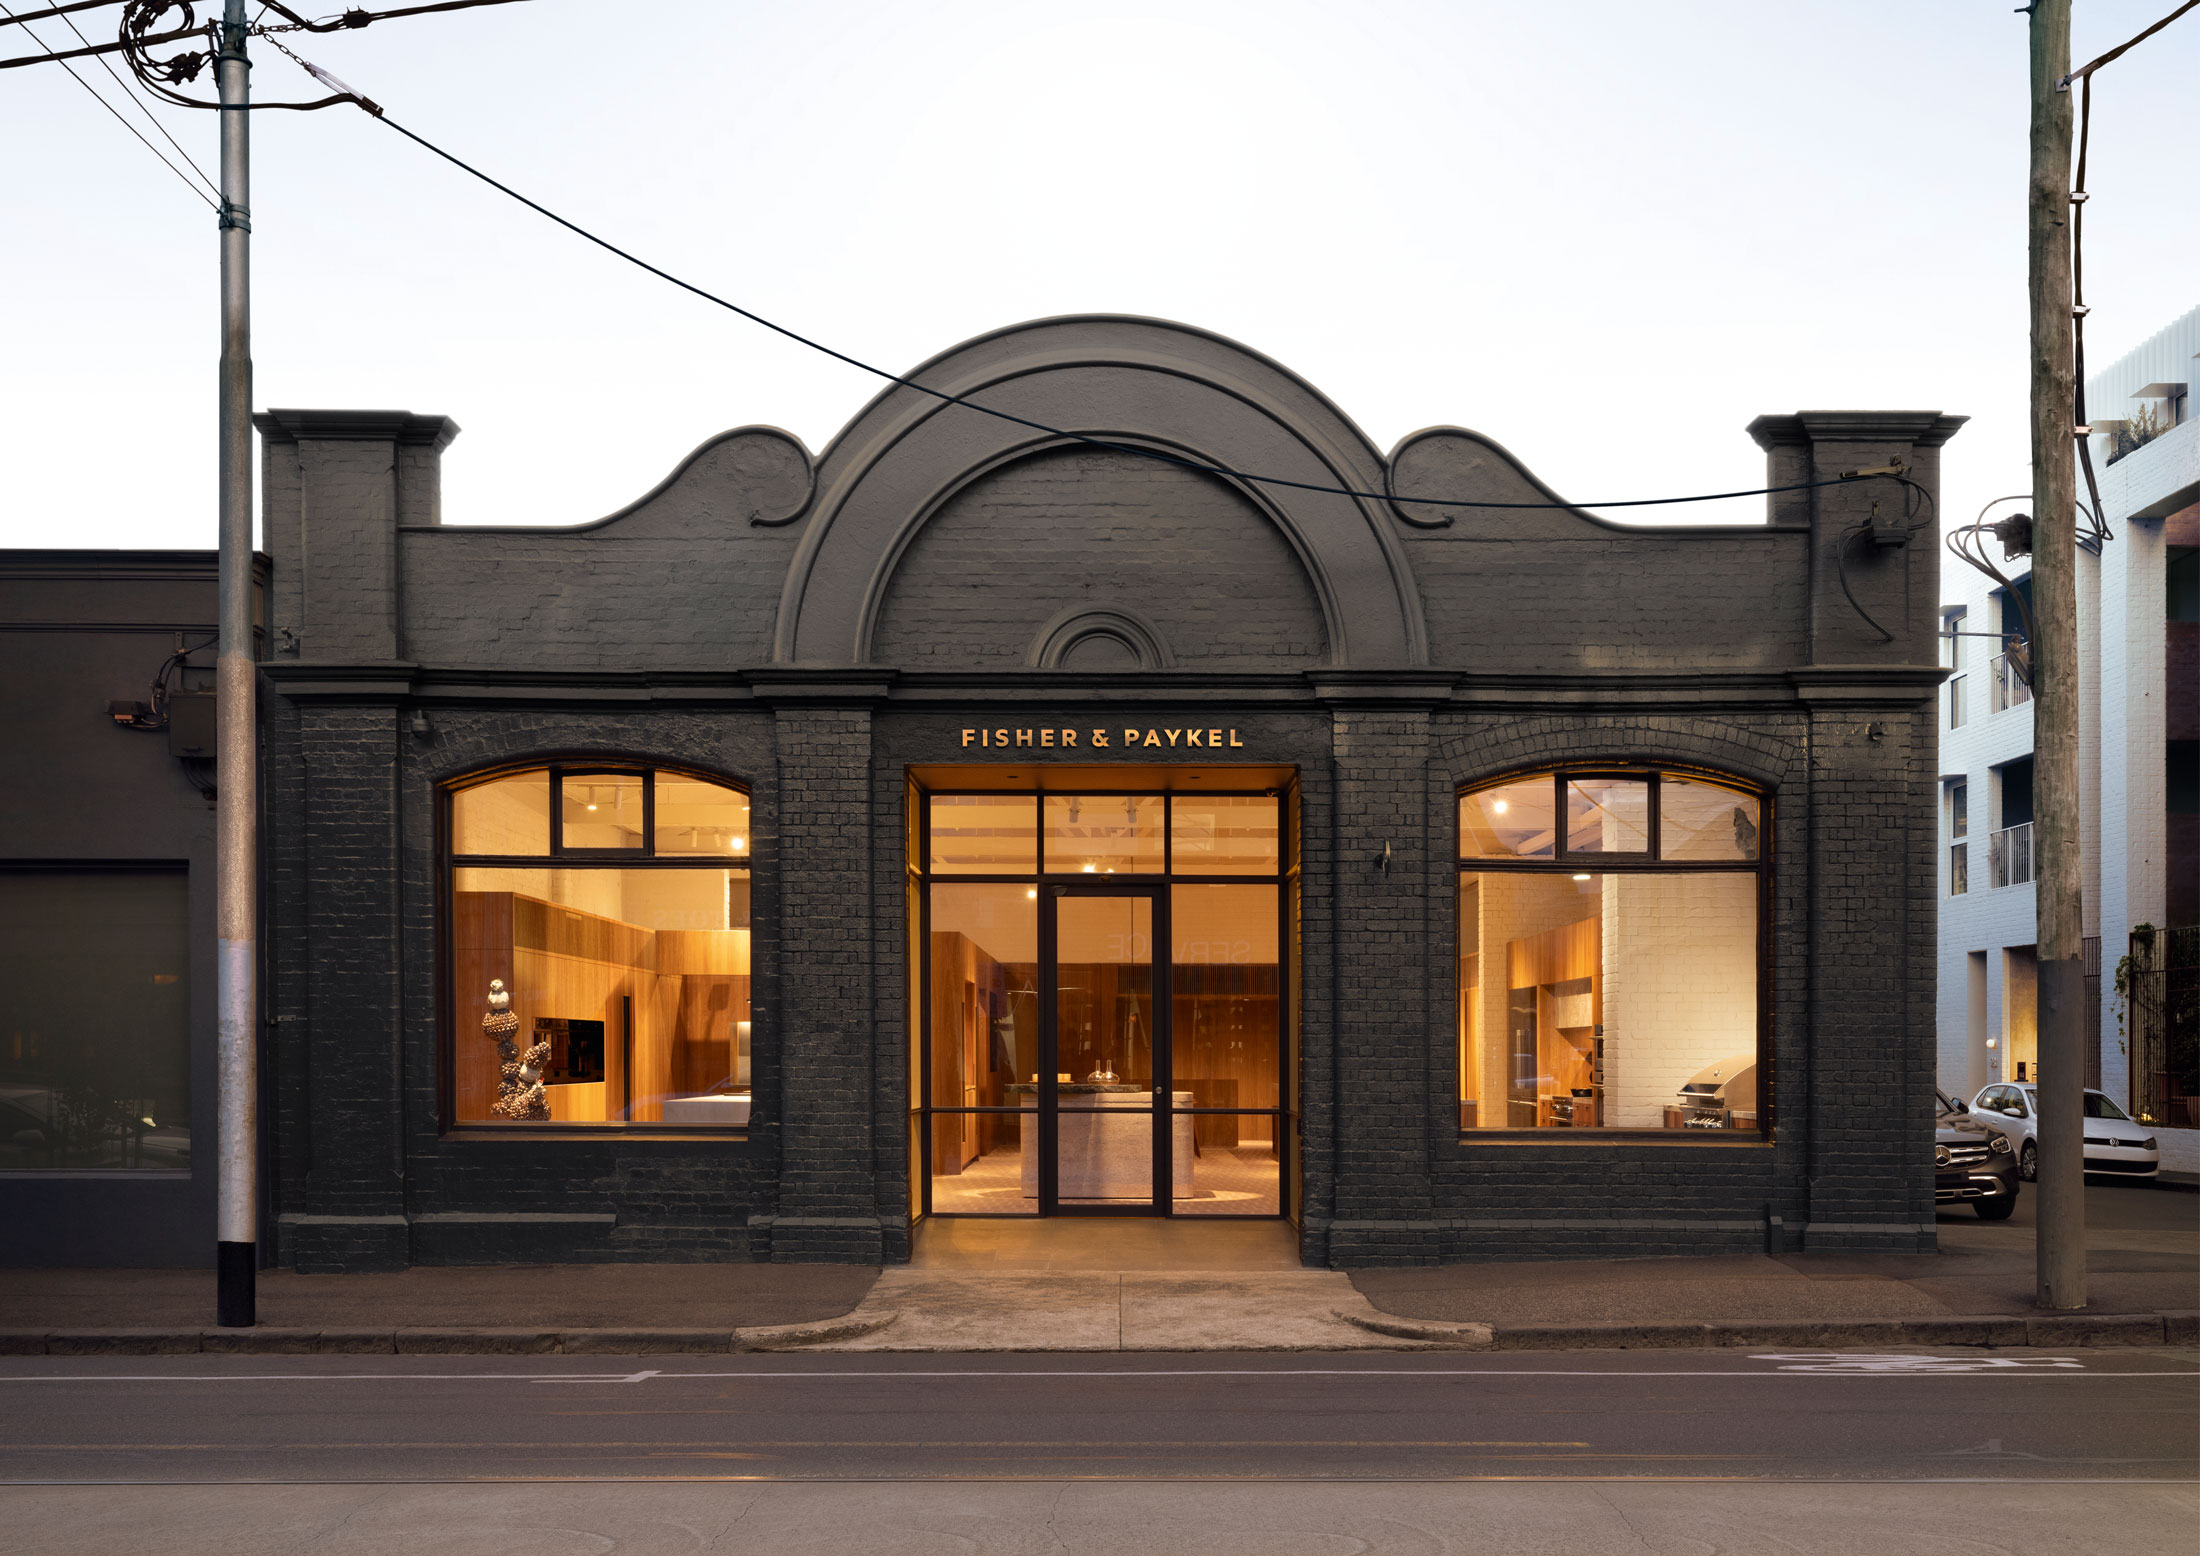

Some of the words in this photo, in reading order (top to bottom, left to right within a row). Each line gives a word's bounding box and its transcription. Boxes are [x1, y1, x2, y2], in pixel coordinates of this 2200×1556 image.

[962, 729, 1078, 747] FISHER
[1091, 729, 1110, 747] &
[1124, 729, 1244, 747] PAYKEL
